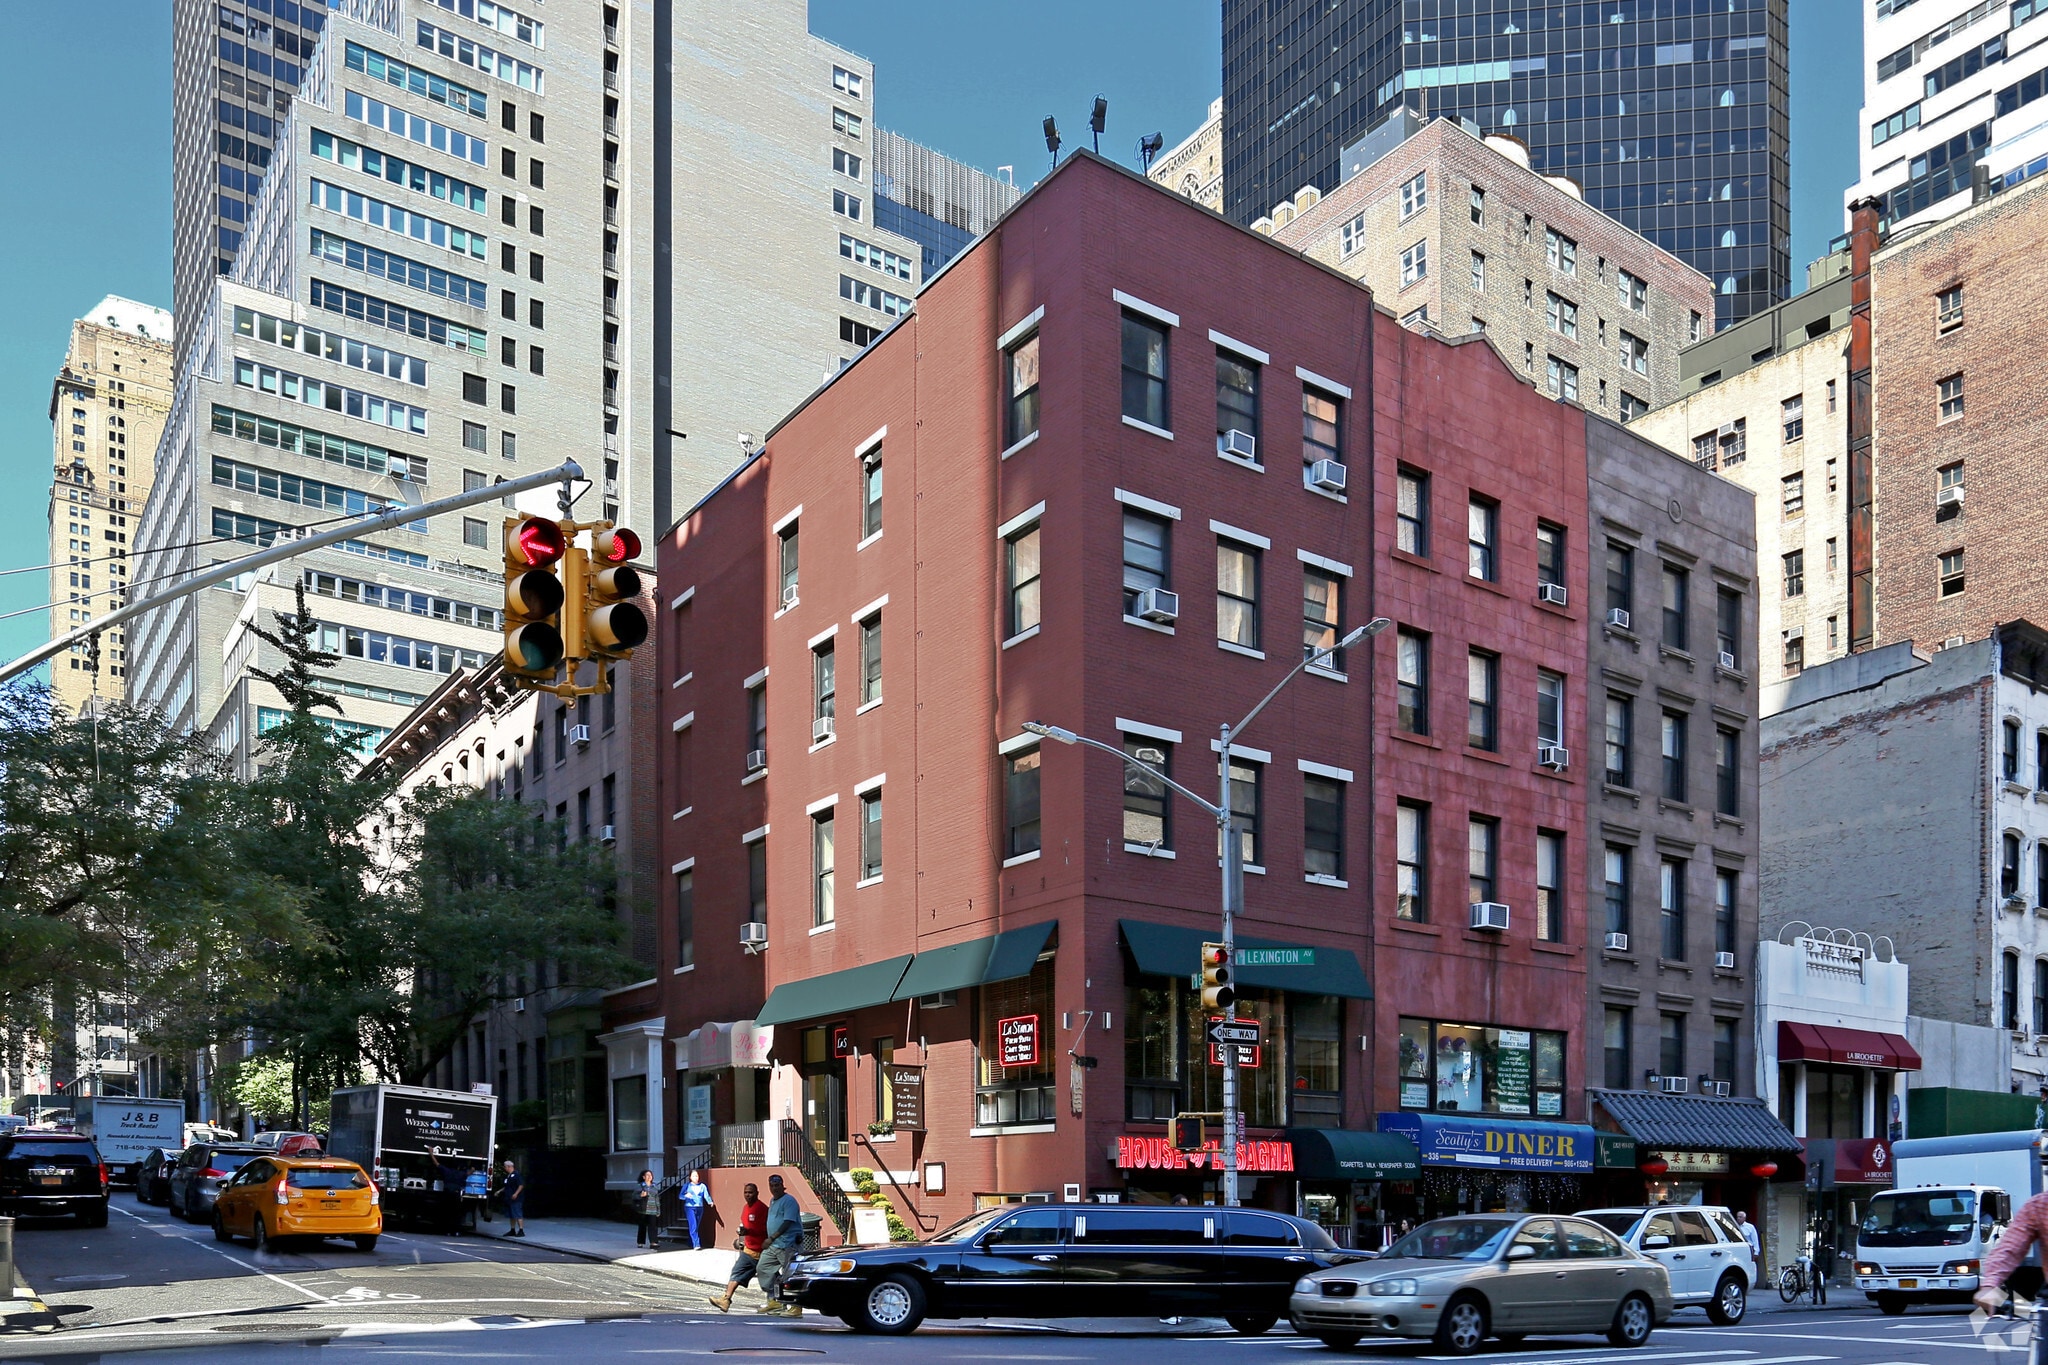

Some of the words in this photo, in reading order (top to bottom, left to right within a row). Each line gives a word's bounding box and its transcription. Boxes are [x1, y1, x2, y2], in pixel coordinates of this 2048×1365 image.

[1247, 950, 1299, 963] LEXINGTON
[1217, 1029, 1232, 1038] ONE
[1238, 1030, 1255, 1039] WAY
[122, 1112, 131, 1121] J
[135, 1112, 144, 1122] &
[149, 1113, 159, 1122] B
[418, 1128, 454, 1136] 718.803.5000
[1485, 1131, 1576, 1157] DINER
[1118, 1136, 1187, 1169] HOUSE
[1211, 1140, 1295, 1172] LSAGNA
[1427, 1152, 1440, 1161] 336
[1510, 1157, 1525, 1166] FREE
[1525, 1157, 1553, 1167] DELIVERY
